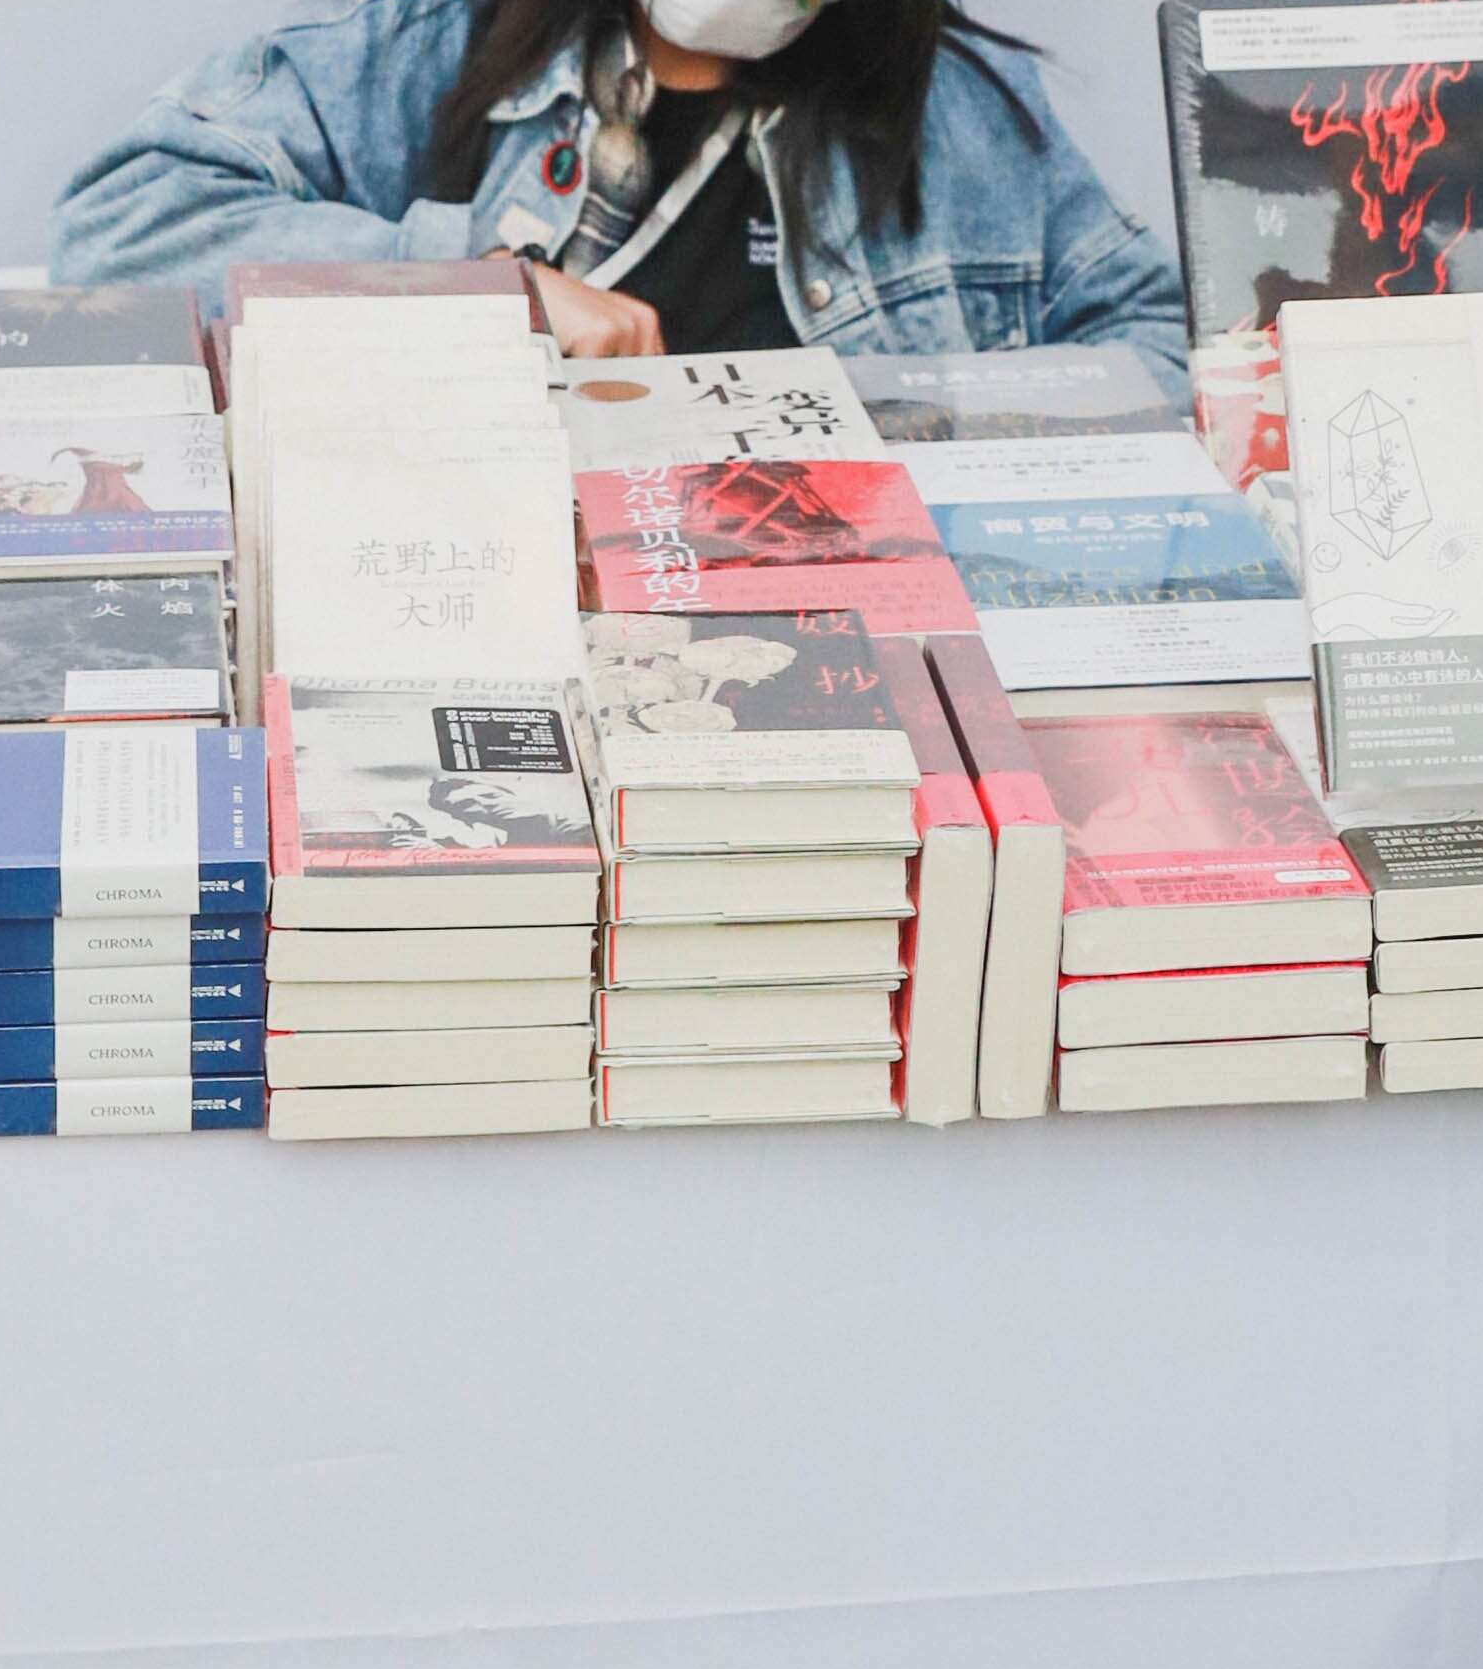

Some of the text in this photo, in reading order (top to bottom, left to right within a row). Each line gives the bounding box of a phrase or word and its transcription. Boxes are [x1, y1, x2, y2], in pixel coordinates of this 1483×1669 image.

[351, 539, 516, 577] 荒野上的
[394, 592, 475, 631] 大师
[95, 887, 162, 901] CHROMA
[88, 937, 154, 951] CHROMA
[88, 993, 154, 1006] CHROMA
[88, 1046, 154, 1060] CHROMA
[90, 1104, 155, 1118] CHROMA
